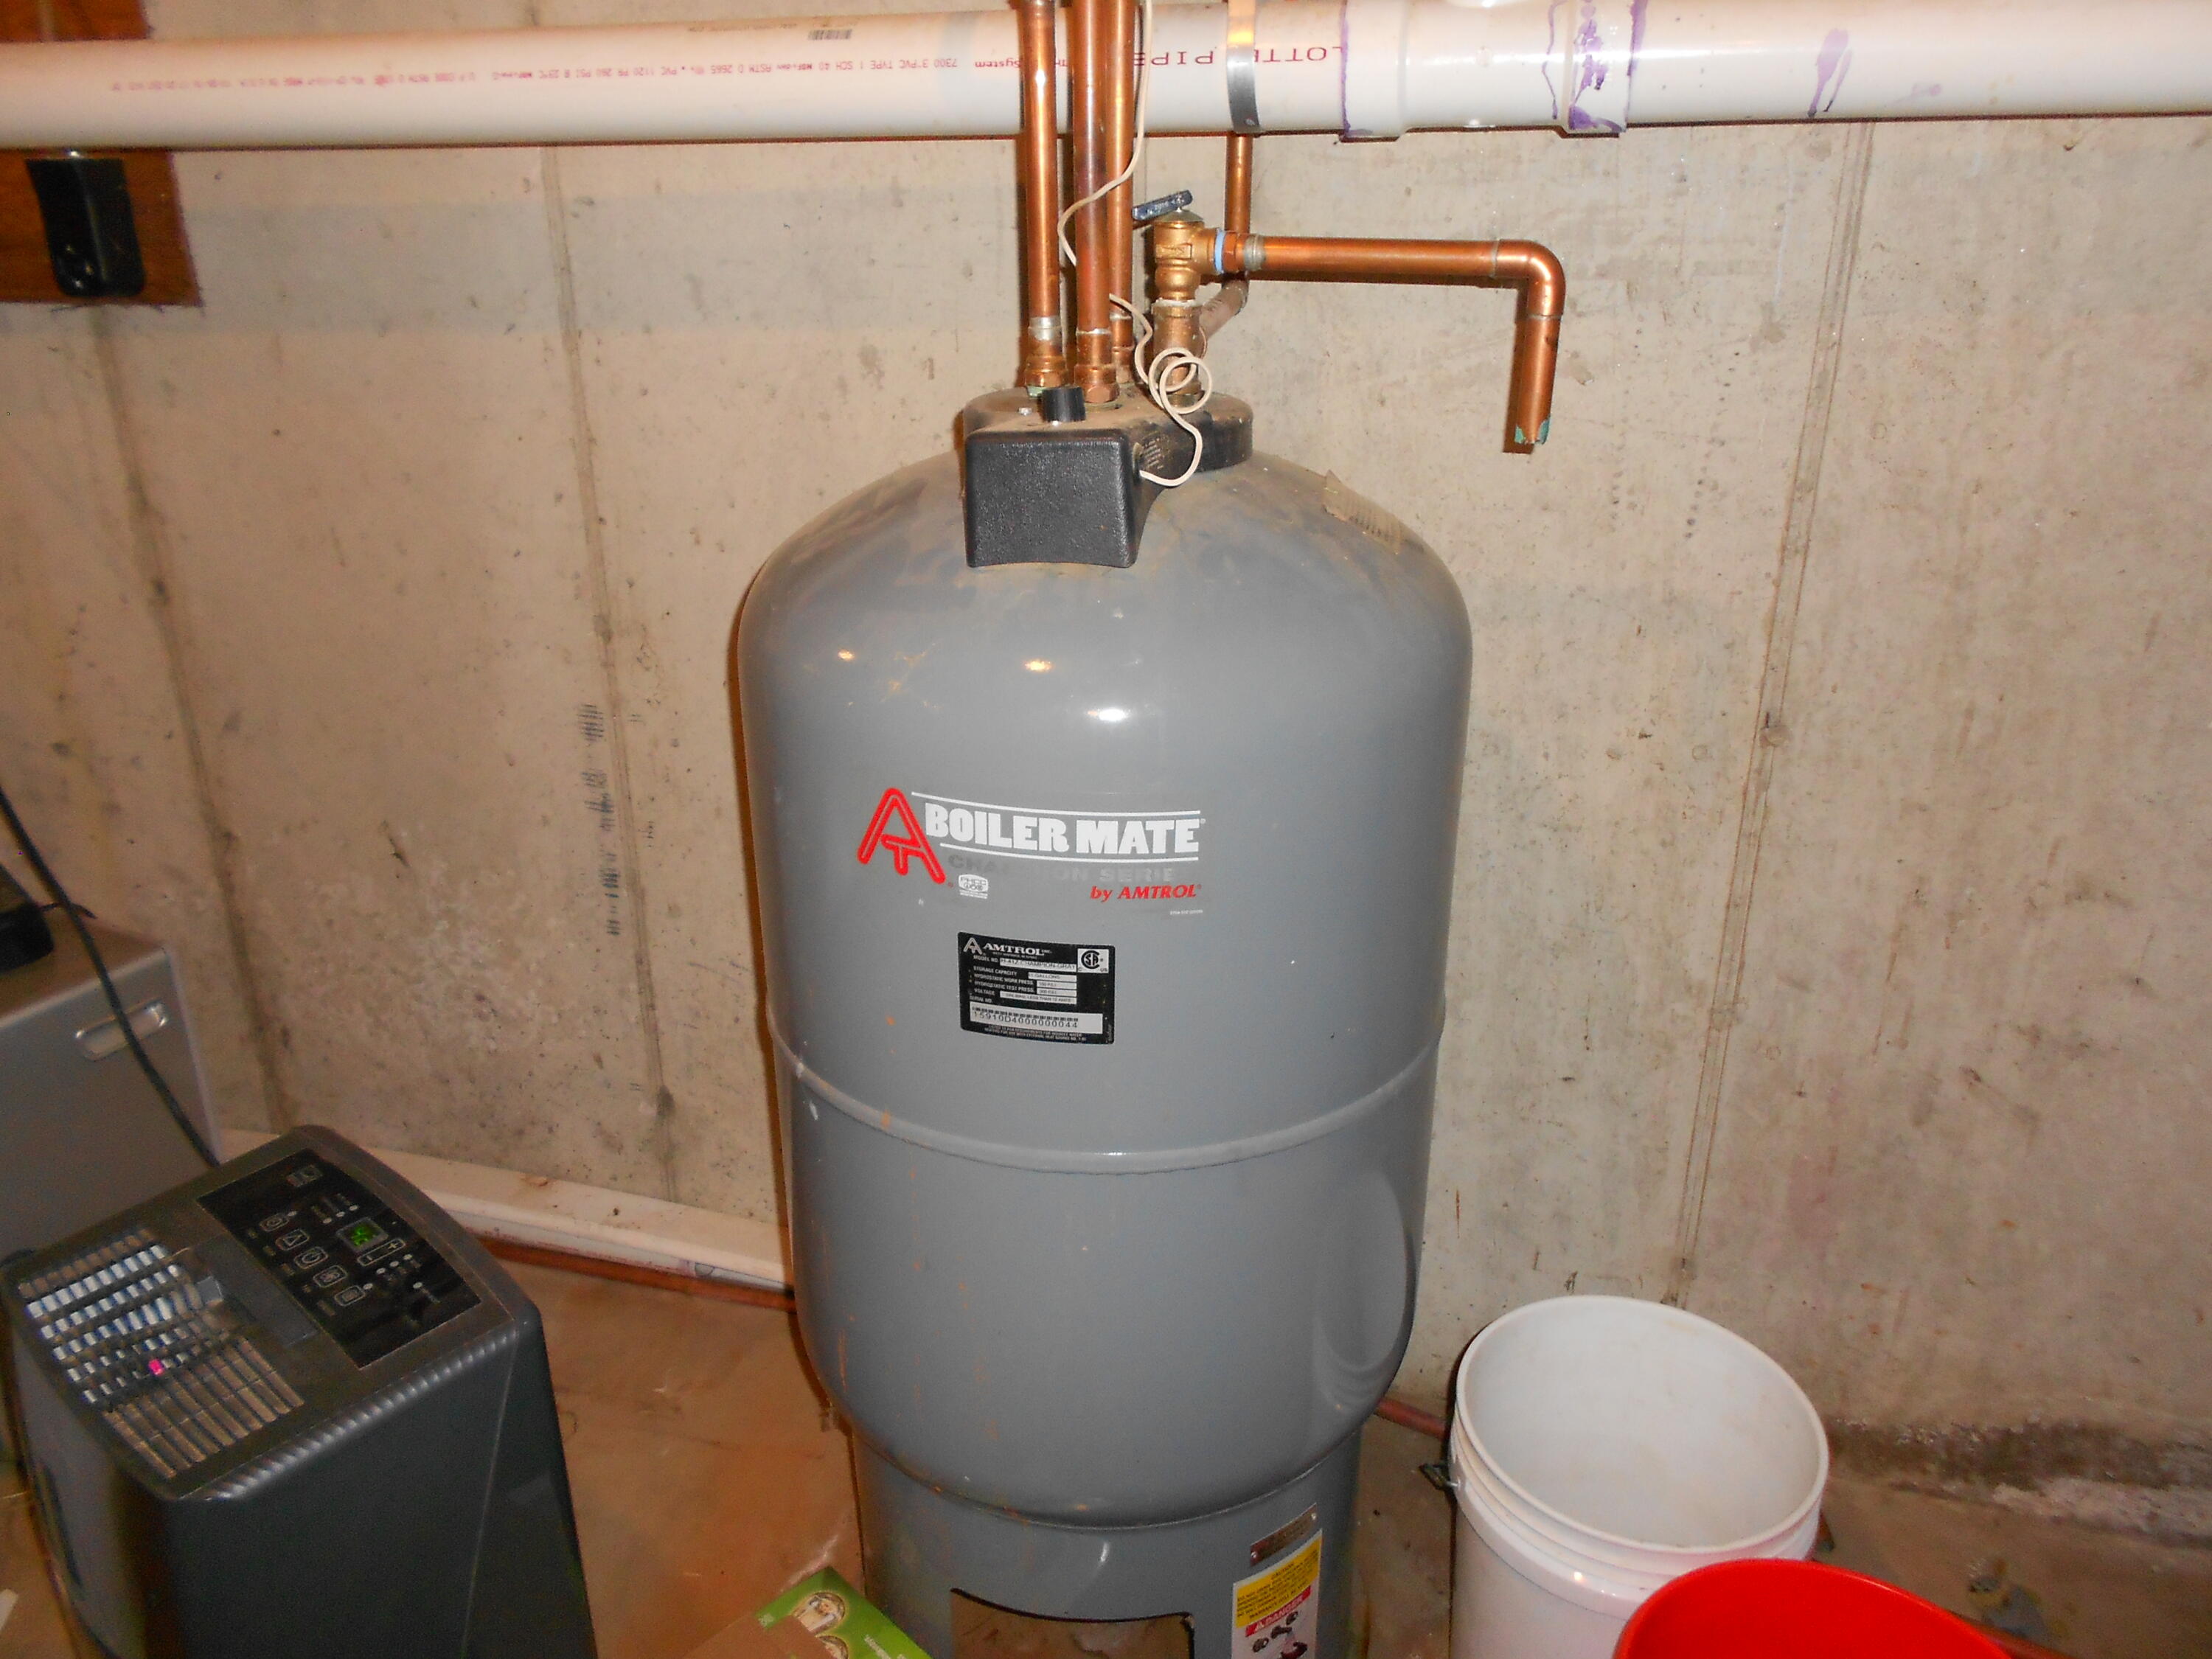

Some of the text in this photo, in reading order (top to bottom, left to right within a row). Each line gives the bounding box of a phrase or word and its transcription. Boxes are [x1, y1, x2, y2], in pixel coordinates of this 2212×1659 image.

[925, 801, 1200, 855] BOILER MATE
[1089, 883, 1197, 903] by AMTROL
[983, 943, 1045, 956] AMTROL
[973, 965, 1018, 976] STORAGE CAPACITY
[973, 973, 1004, 982] HYDROSTATIC
[974, 981, 1006, 990] HYDROSTATIC
